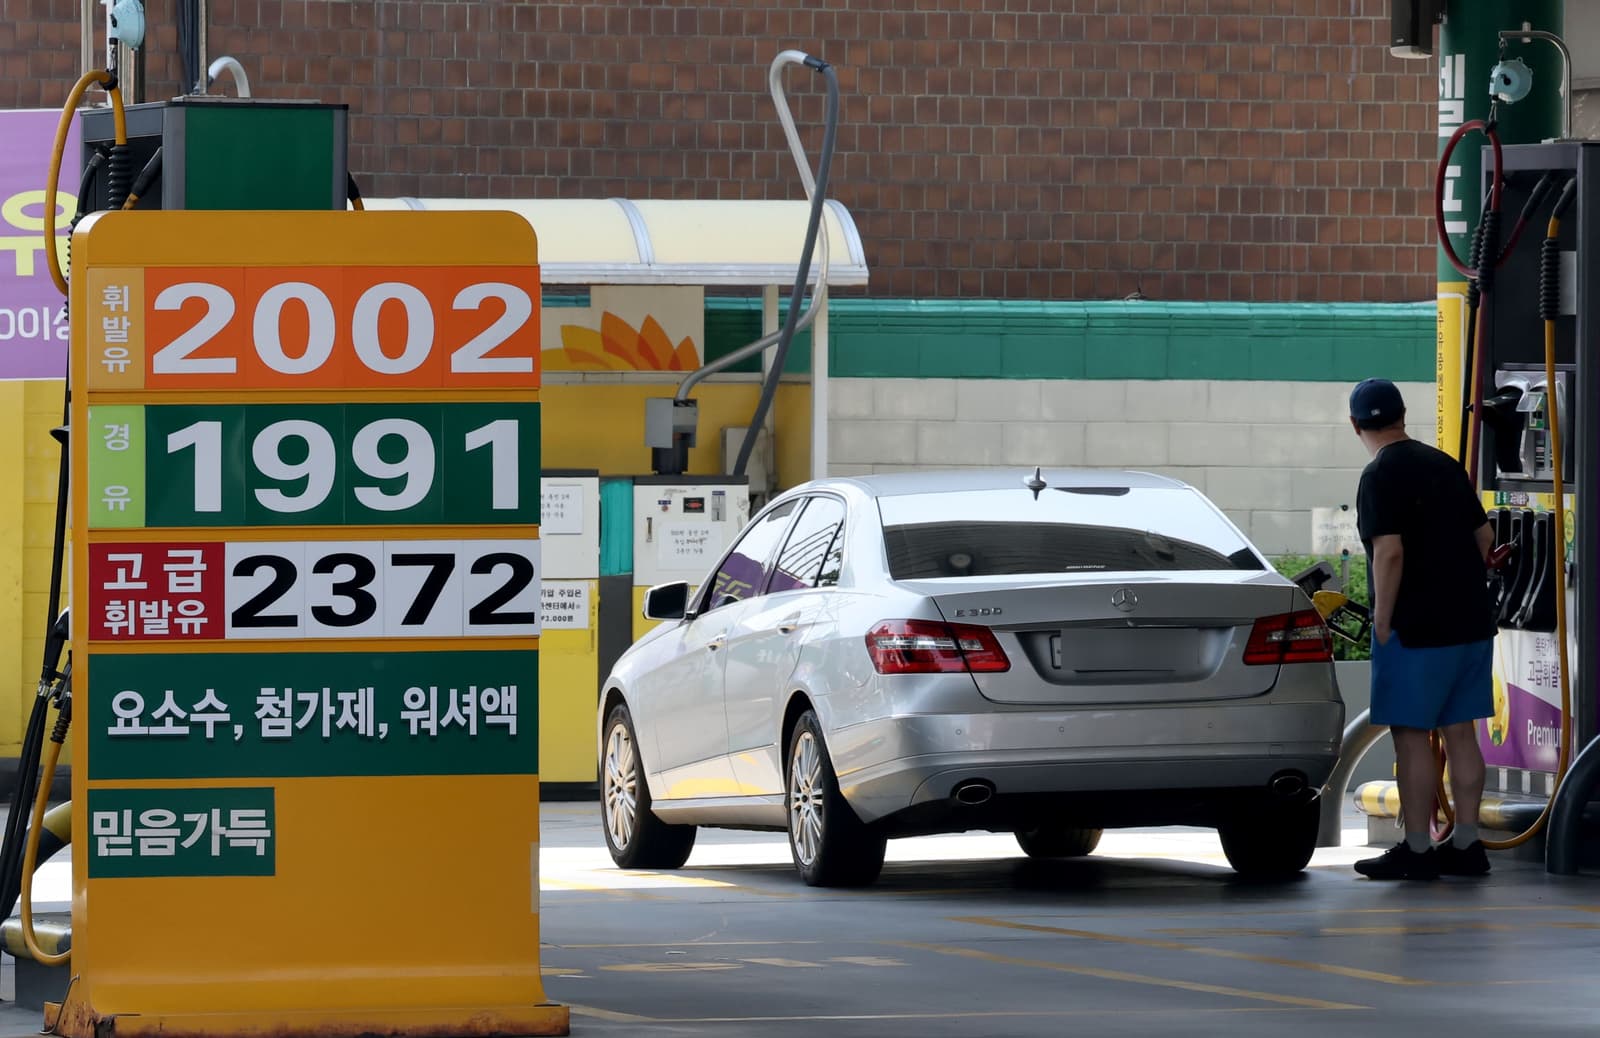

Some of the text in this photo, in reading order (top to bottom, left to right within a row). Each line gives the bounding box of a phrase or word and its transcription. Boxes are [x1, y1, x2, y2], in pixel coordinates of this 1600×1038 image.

[101, 285, 132, 373] 휘발유
[152, 281, 534, 374] 2002
[167, 418, 519, 513] 1991
[104, 599, 208, 636] 휘발유
[231, 552, 535, 628] 2372
[559, 588, 582, 598] 주입은
[107, 685, 518, 741] 요소수, 첨가제, 워셔액
[93, 808, 271, 857] 믿음가득
